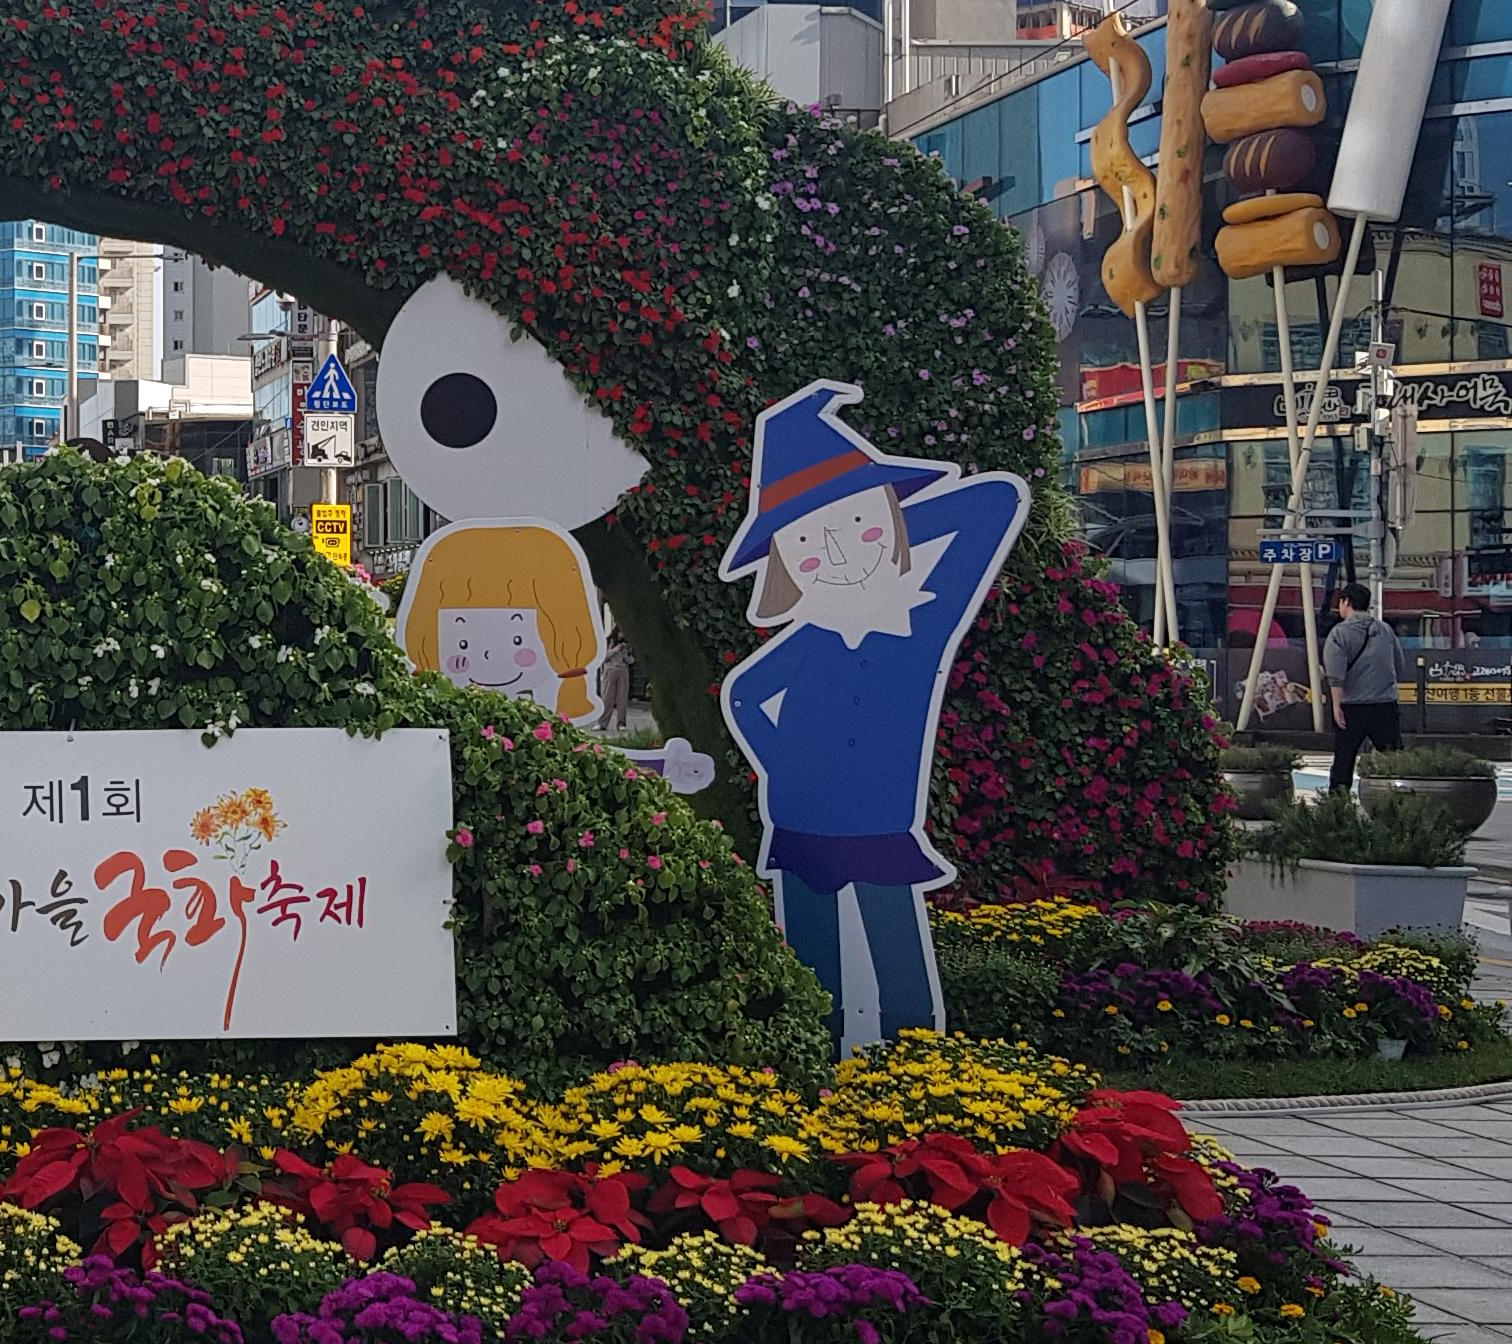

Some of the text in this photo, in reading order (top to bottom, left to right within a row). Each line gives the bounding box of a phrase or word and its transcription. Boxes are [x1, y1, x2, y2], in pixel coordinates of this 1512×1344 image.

[311, 420, 348, 432] 견인지역
[317, 521, 345, 532] CCTV
[1263, 543, 1332, 562] 주차장 P
[21, 775, 143, 824] 제1회
